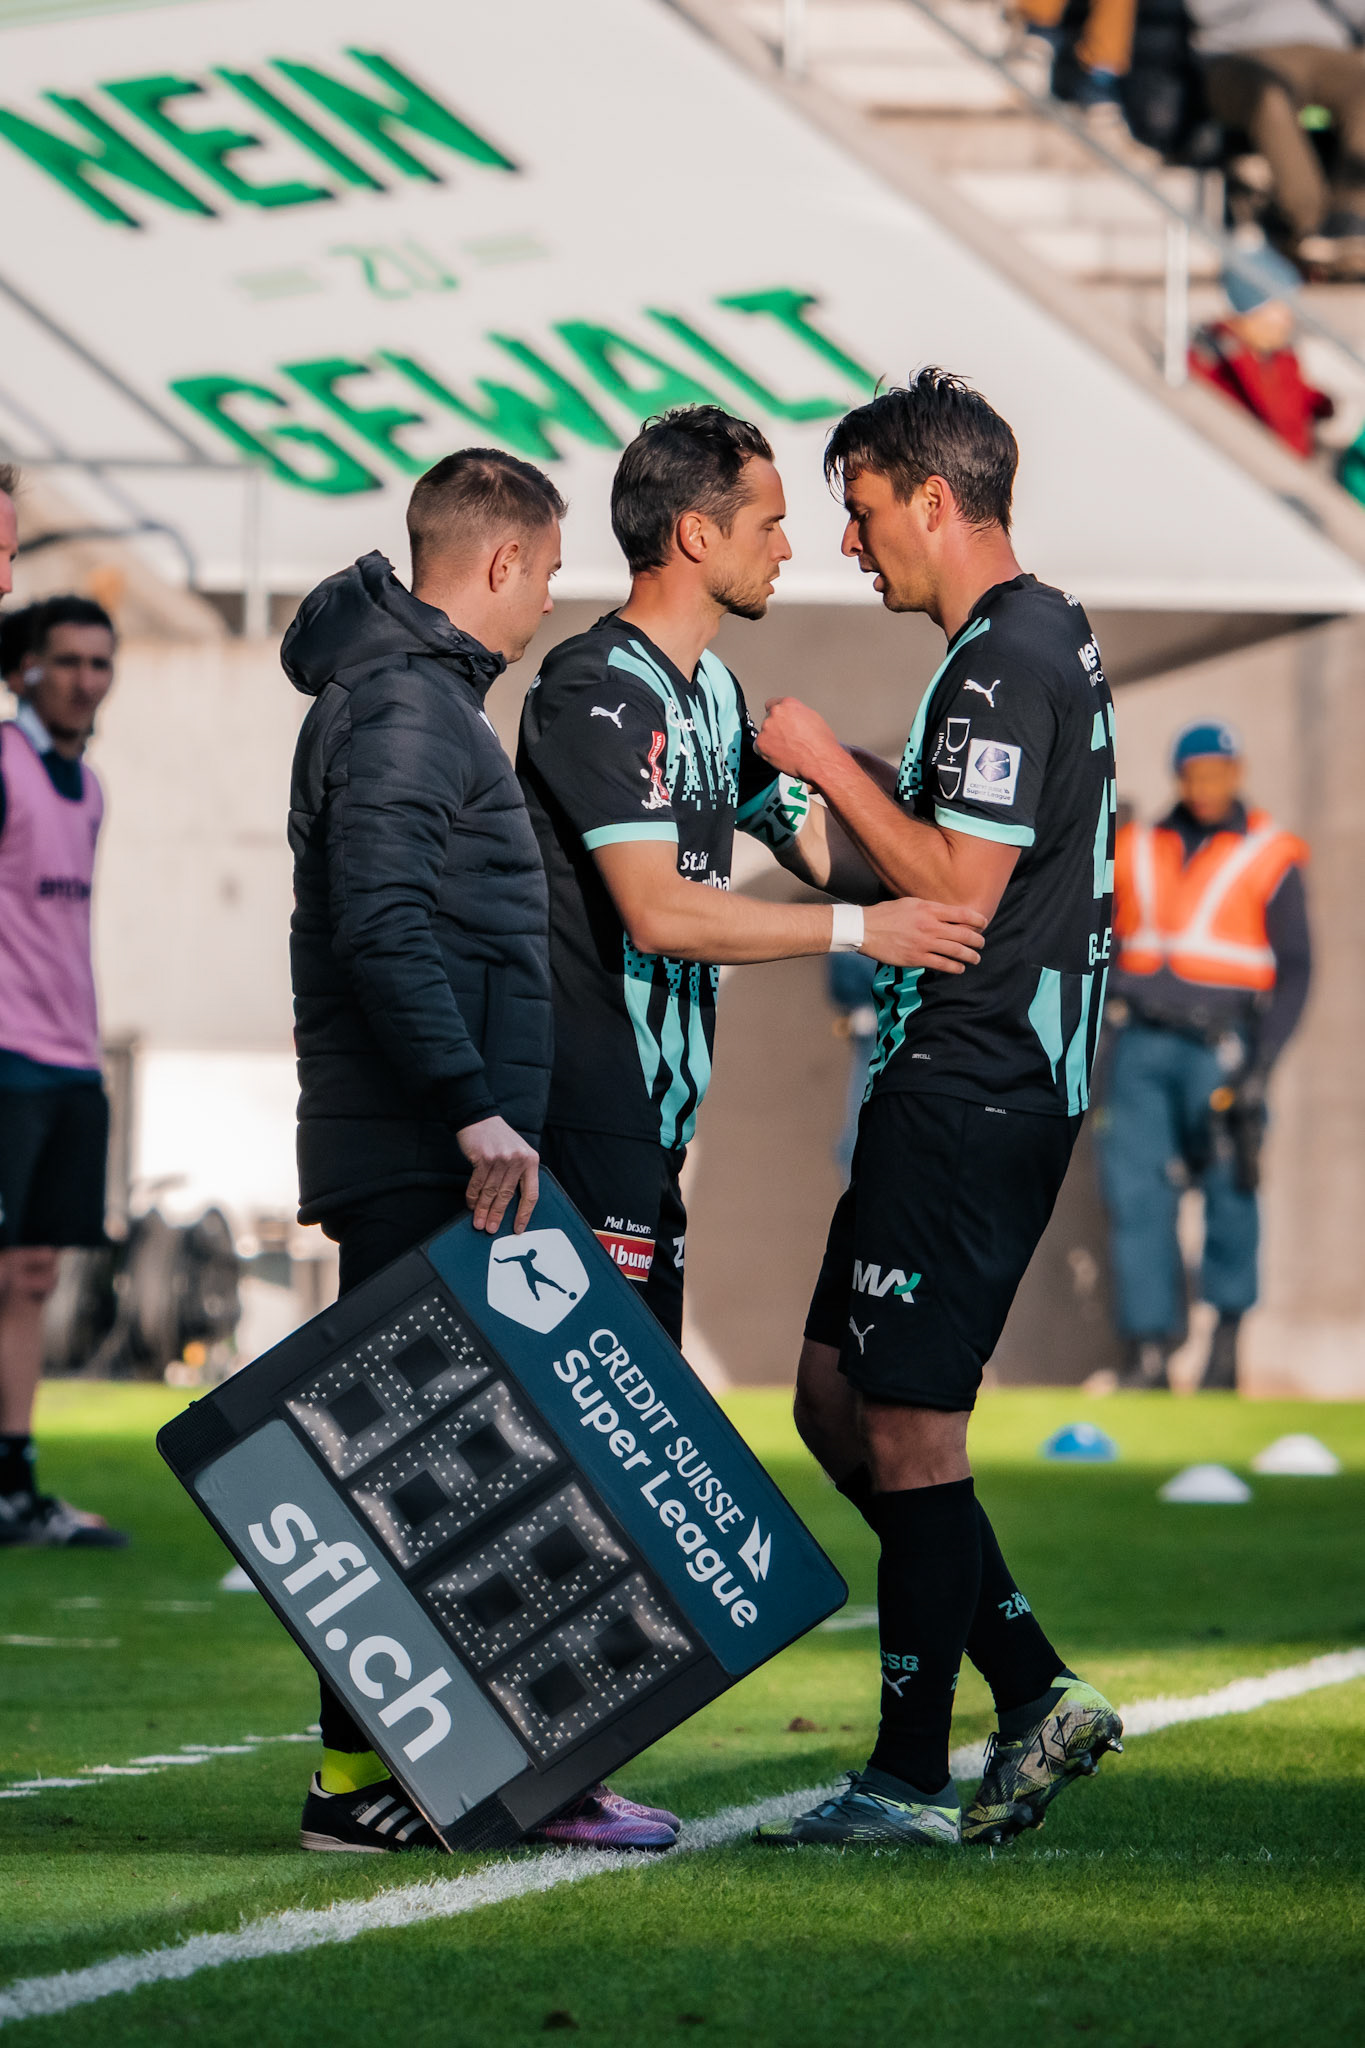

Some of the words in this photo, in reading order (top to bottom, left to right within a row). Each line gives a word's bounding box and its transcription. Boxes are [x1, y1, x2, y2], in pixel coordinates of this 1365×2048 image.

[0, 46, 520, 228] NEIN
[330, 240, 460, 299] ZU
[169, 288, 886, 496] GEWALT
[604, 1215, 624, 1230] Mal
[852, 1258, 922, 1304] MAX
[552, 1349, 652, 1471] Super
[640, 1470, 758, 1628] League
[588, 1328, 679, 1434] CREDIT
[664, 1436, 745, 1534] SUISSE
[248, 1503, 453, 1763] sfl.ch
